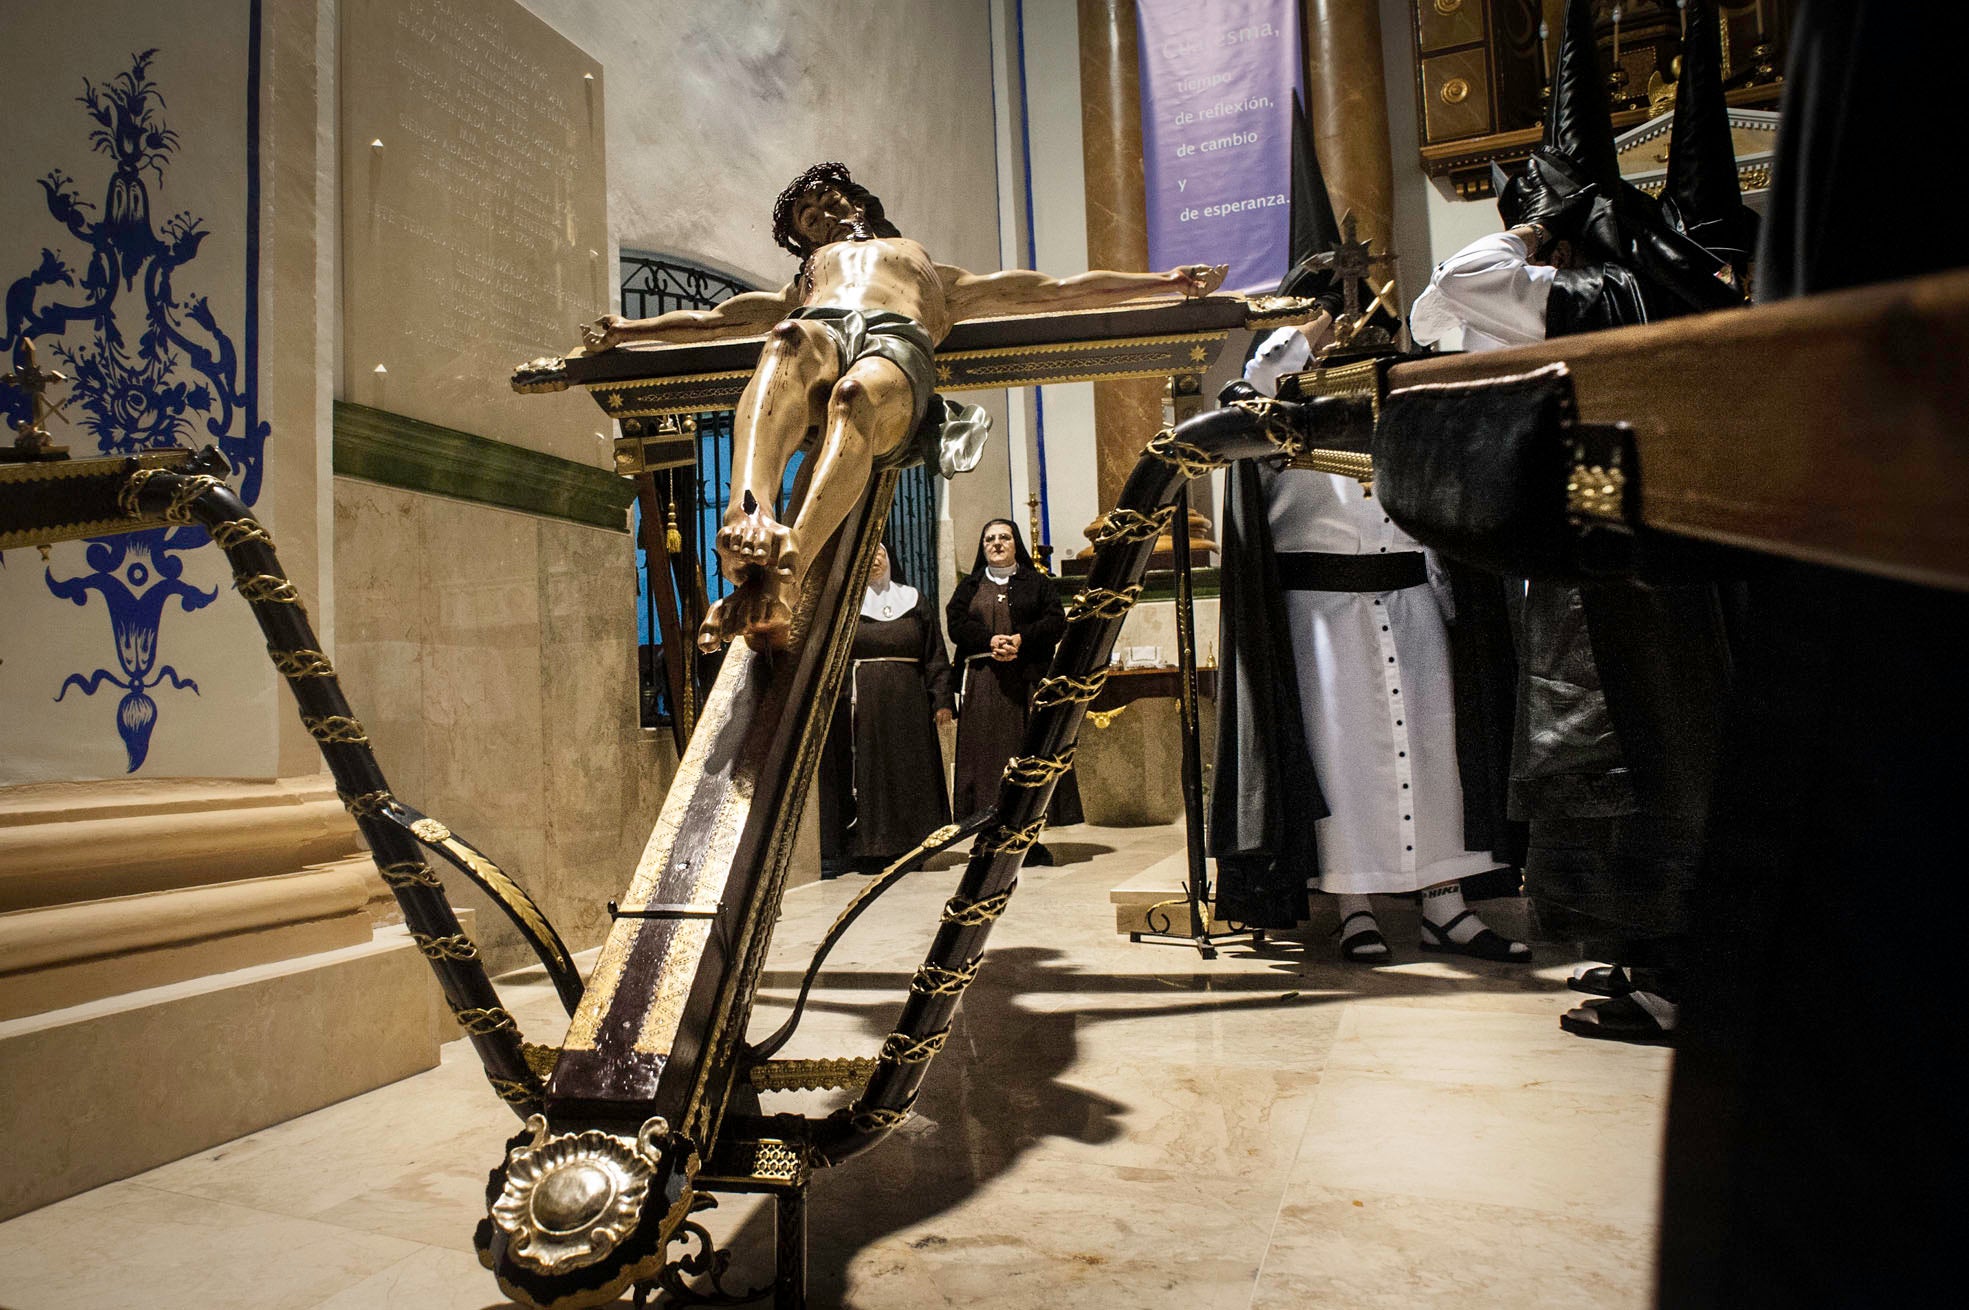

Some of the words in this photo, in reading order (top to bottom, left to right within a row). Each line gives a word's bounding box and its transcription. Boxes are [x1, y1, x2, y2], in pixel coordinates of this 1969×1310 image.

[1162, 22, 1280, 59] Cuaesma,
[1177, 71, 1232, 94] tiempo
[1175, 112, 1194, 126] de
[1199, 96, 1275, 120] reflexión,
[1176, 144, 1196, 158] de
[1200, 132, 1258, 152] cambio
[1178, 179, 1187, 192] y
[1180, 208, 1199, 222] de
[1203, 194, 1290, 217] esperanza.
